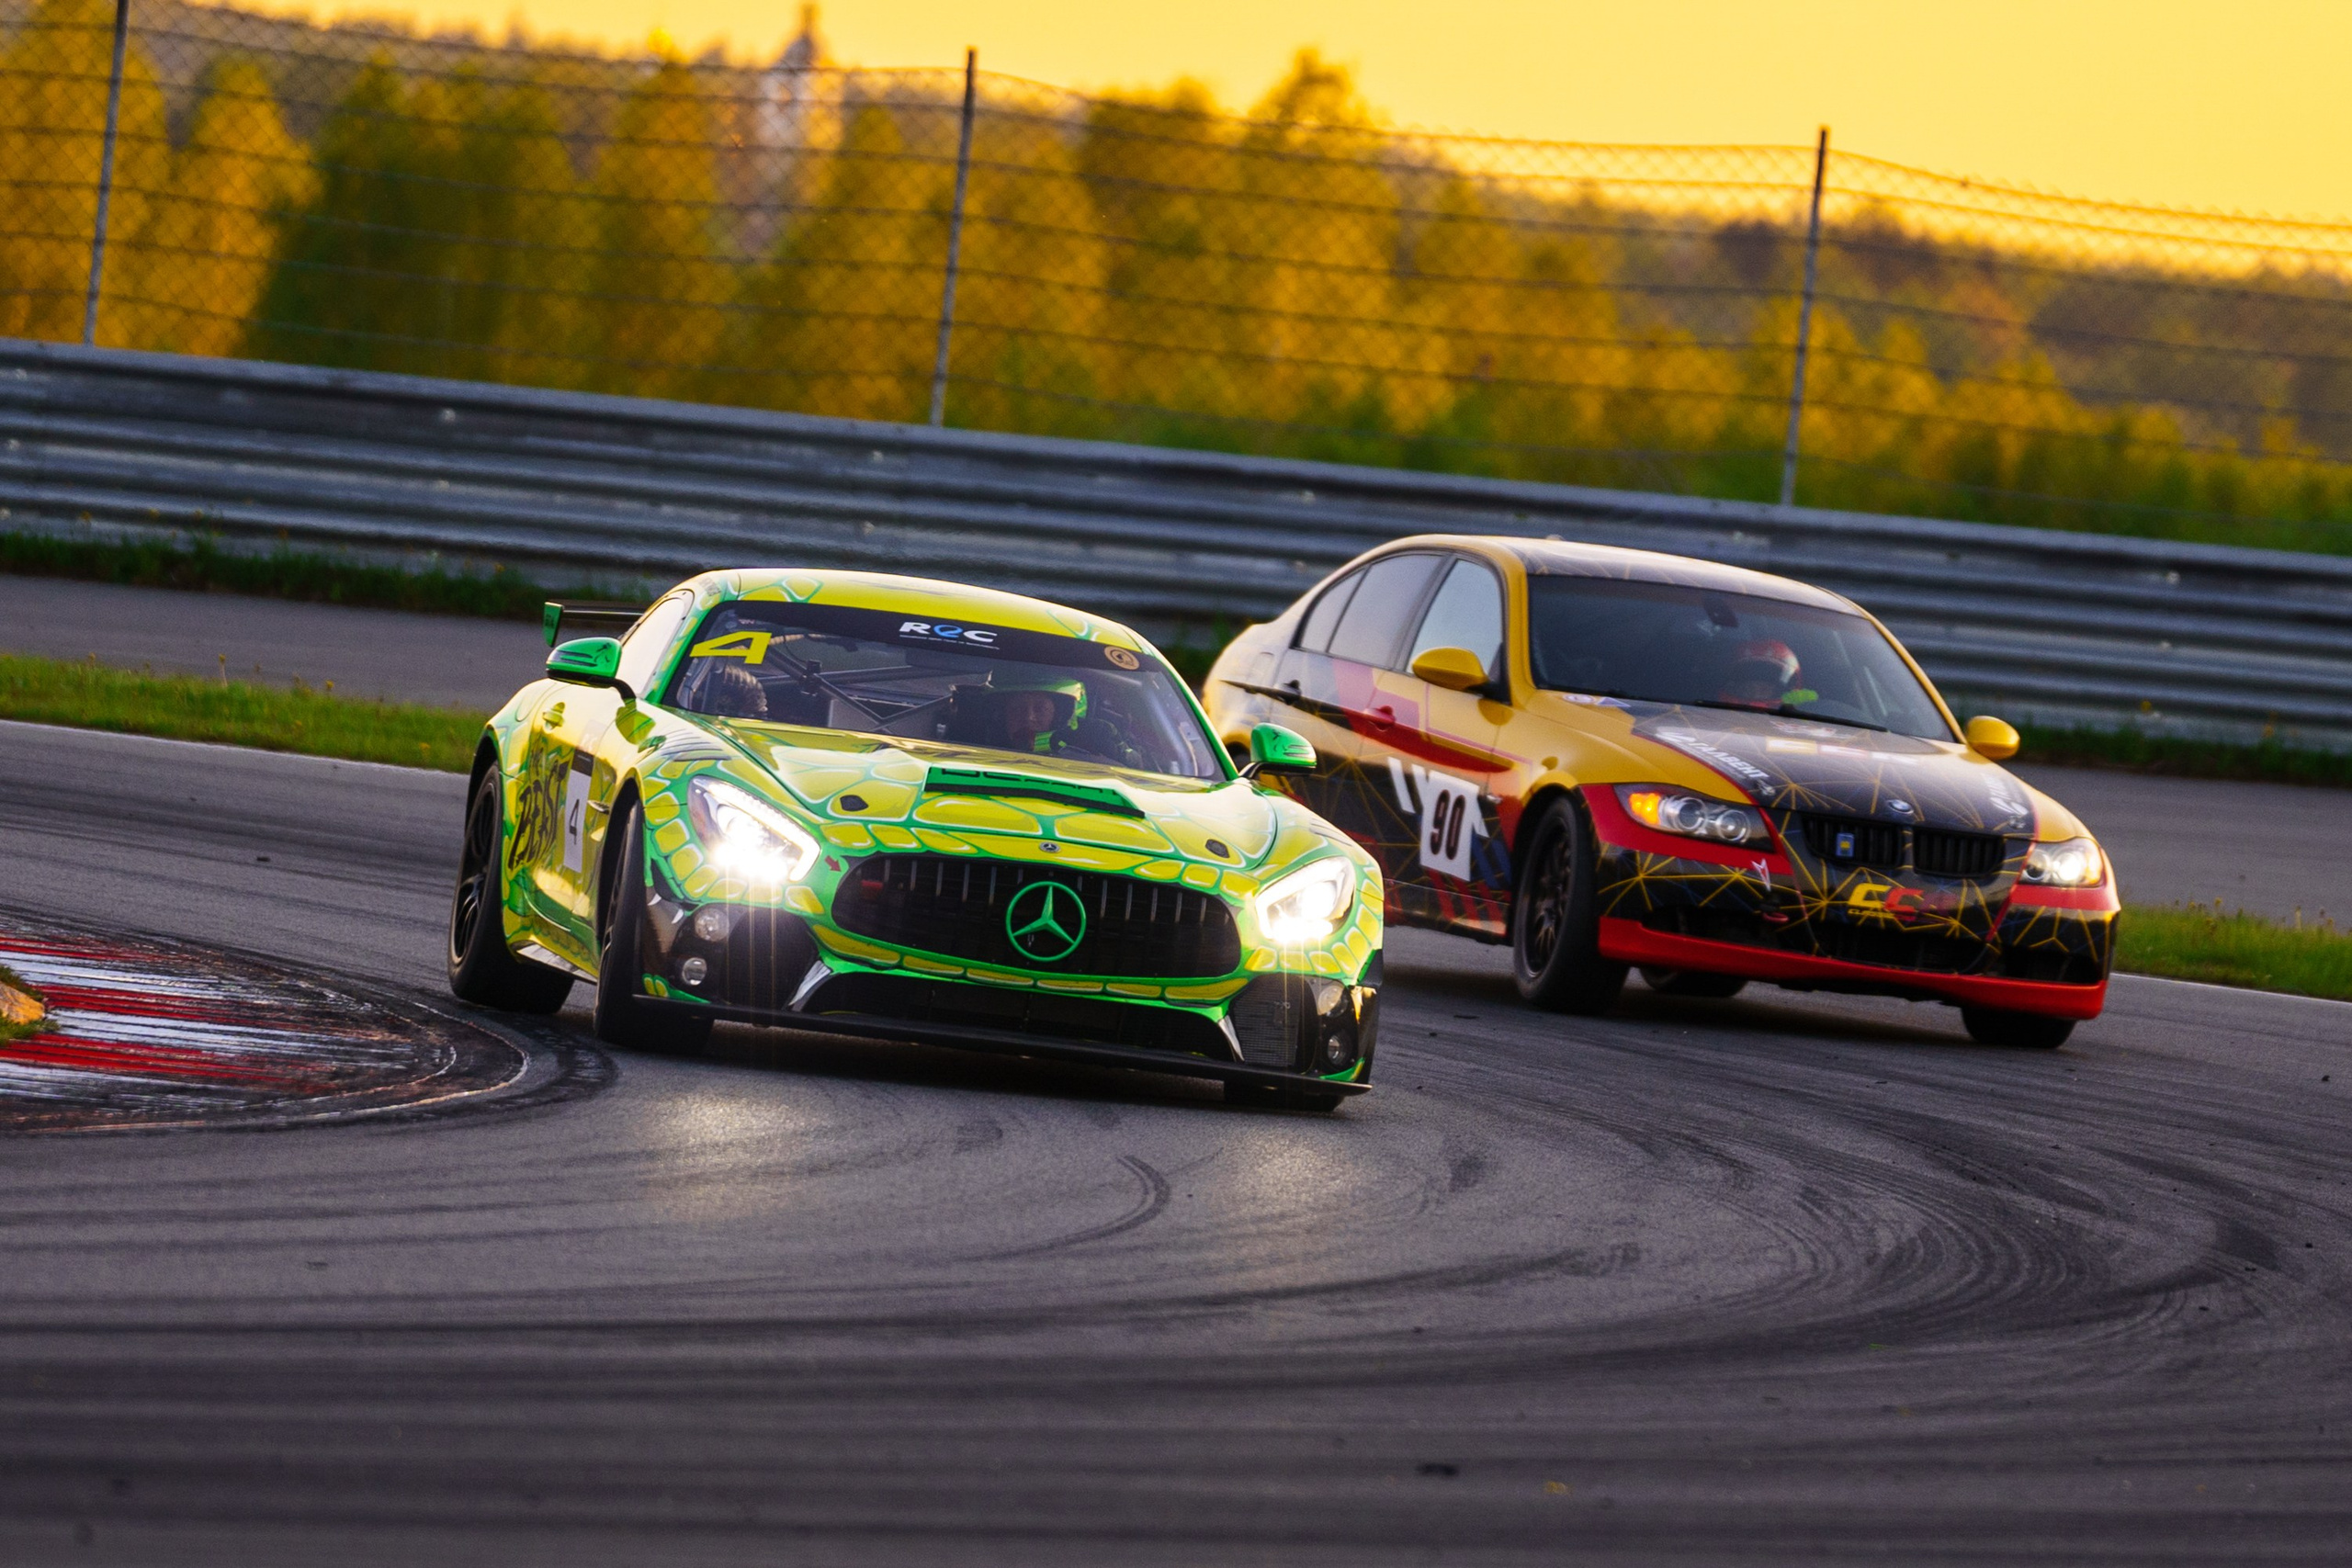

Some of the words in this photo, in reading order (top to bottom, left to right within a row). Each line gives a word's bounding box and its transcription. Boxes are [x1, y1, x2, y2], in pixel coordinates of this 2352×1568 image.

[689, 631, 772, 664] 4
[570, 798, 580, 845] 4
[1430, 789, 1465, 860] 90
